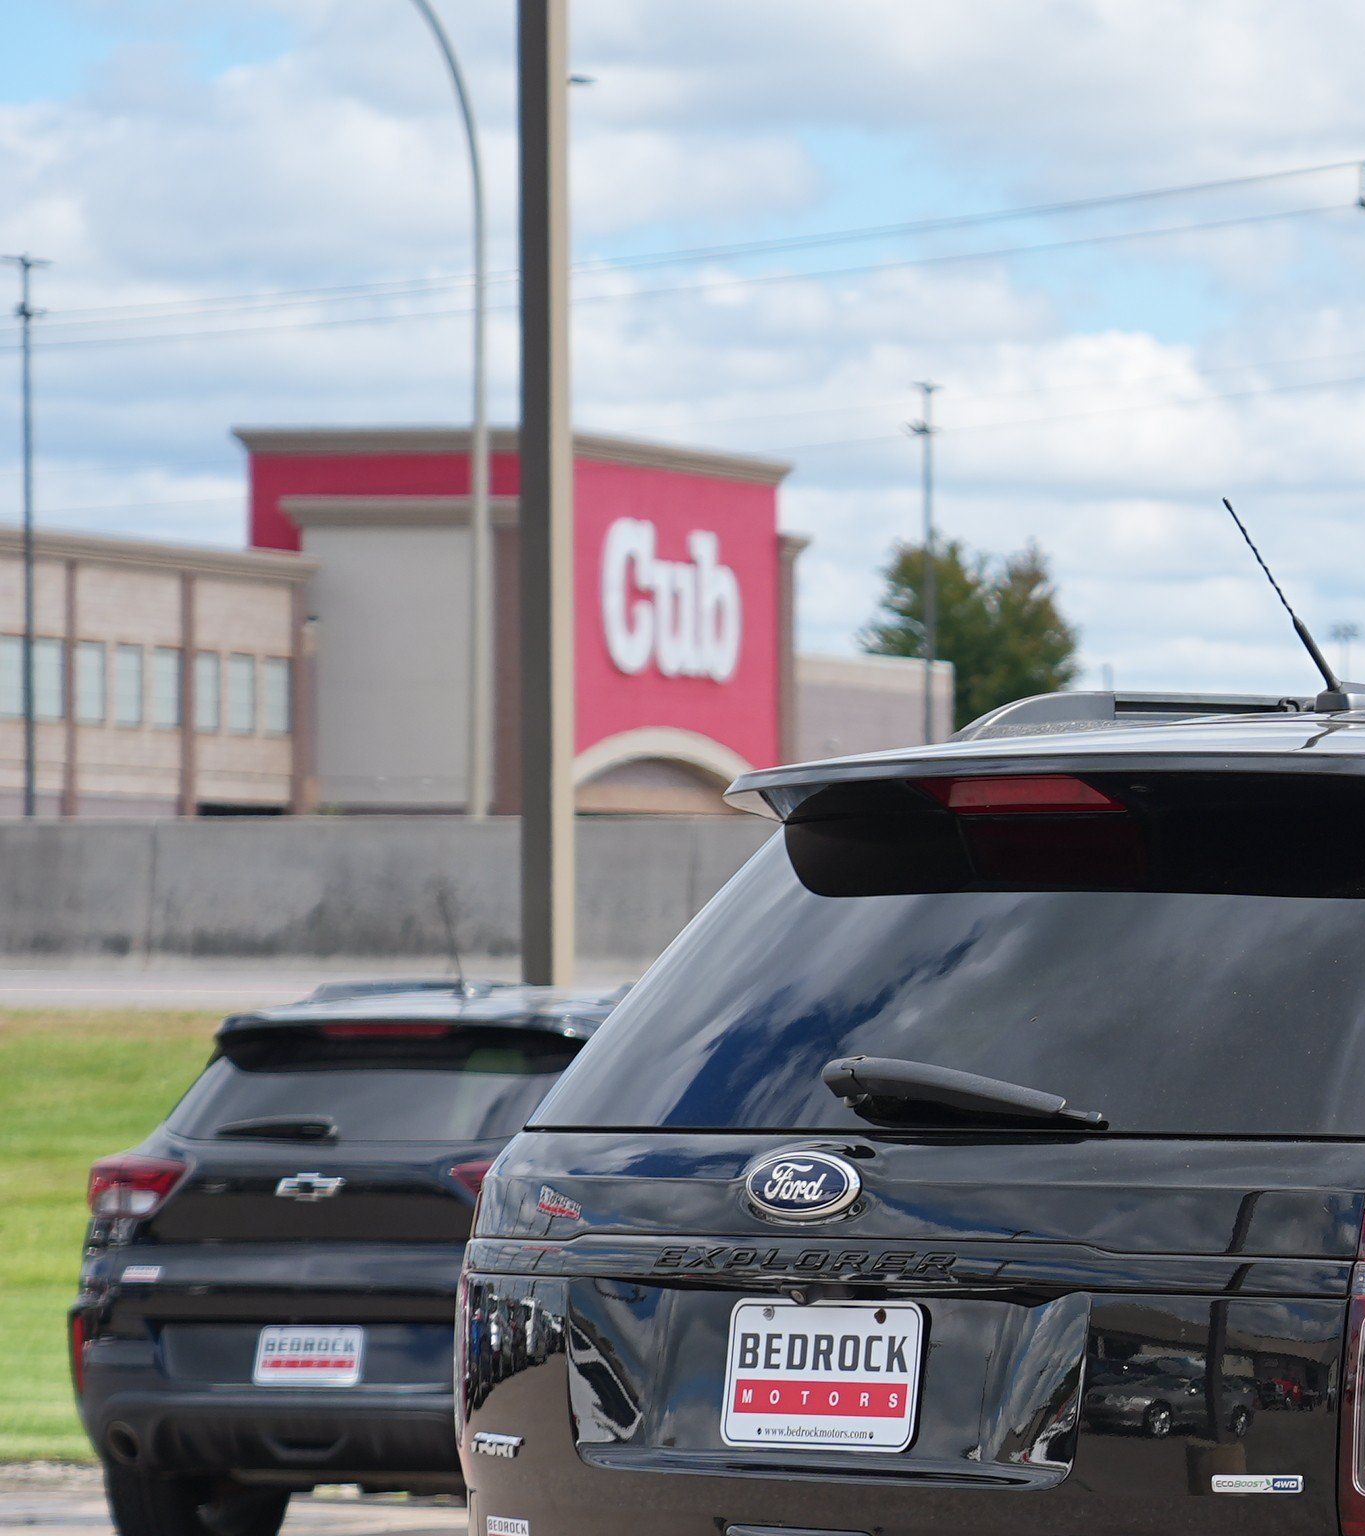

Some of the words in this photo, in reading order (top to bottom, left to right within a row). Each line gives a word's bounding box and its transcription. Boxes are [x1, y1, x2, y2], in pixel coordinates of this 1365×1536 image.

[602, 516, 743, 684] Cub
[764, 1162, 828, 1201] Ford
[652, 1246, 959, 1273] EXPLORER
[264, 1338, 355, 1352] BEDROCK
[738, 1332, 909, 1373] BEDROCK
[741, 1388, 900, 1409] MOTORS
[764, 1426, 868, 1439] www.bedrockmotors.com
[1215, 1480, 1264, 1488] ECOBOOST
[1273, 1480, 1297, 1489] 4WD
[487, 1520, 527, 1535] BEDROCK
